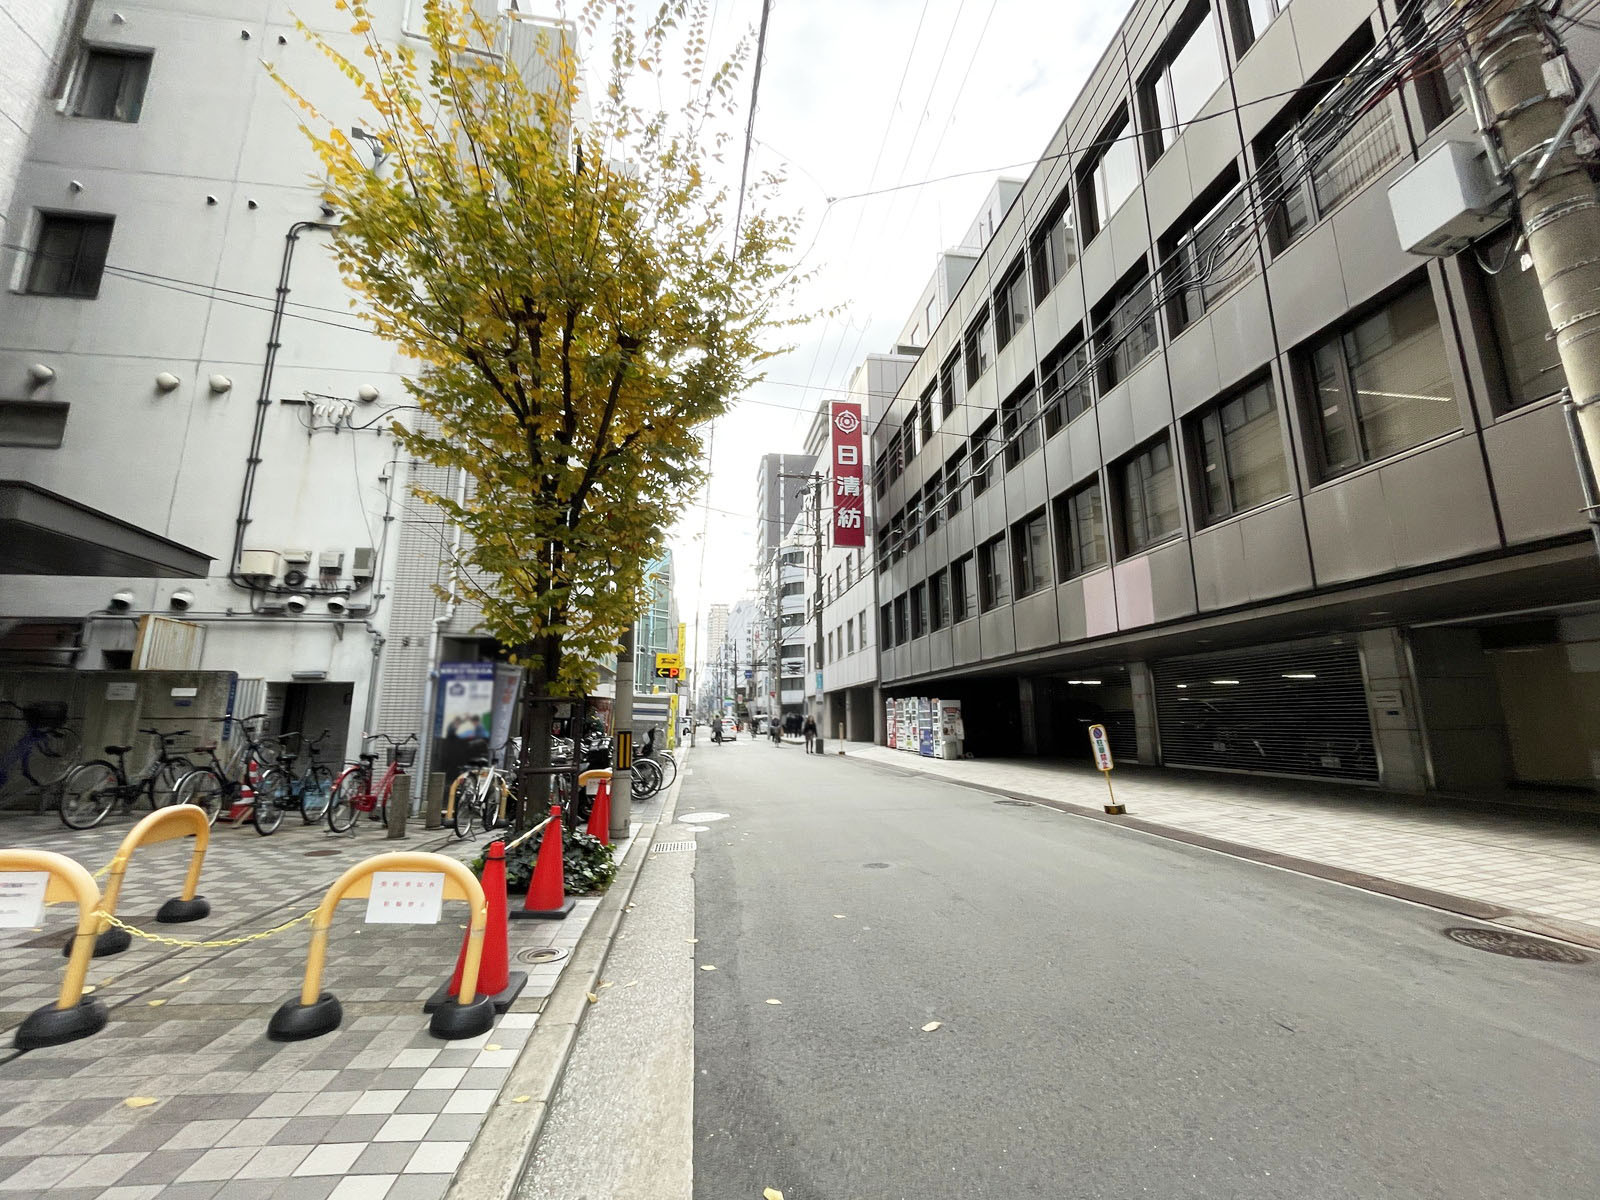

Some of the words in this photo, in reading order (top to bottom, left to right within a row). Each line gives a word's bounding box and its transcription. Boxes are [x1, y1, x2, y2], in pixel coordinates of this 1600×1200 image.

[837, 445, 861, 529] 日清紡
[670, 669, 679, 678] P
